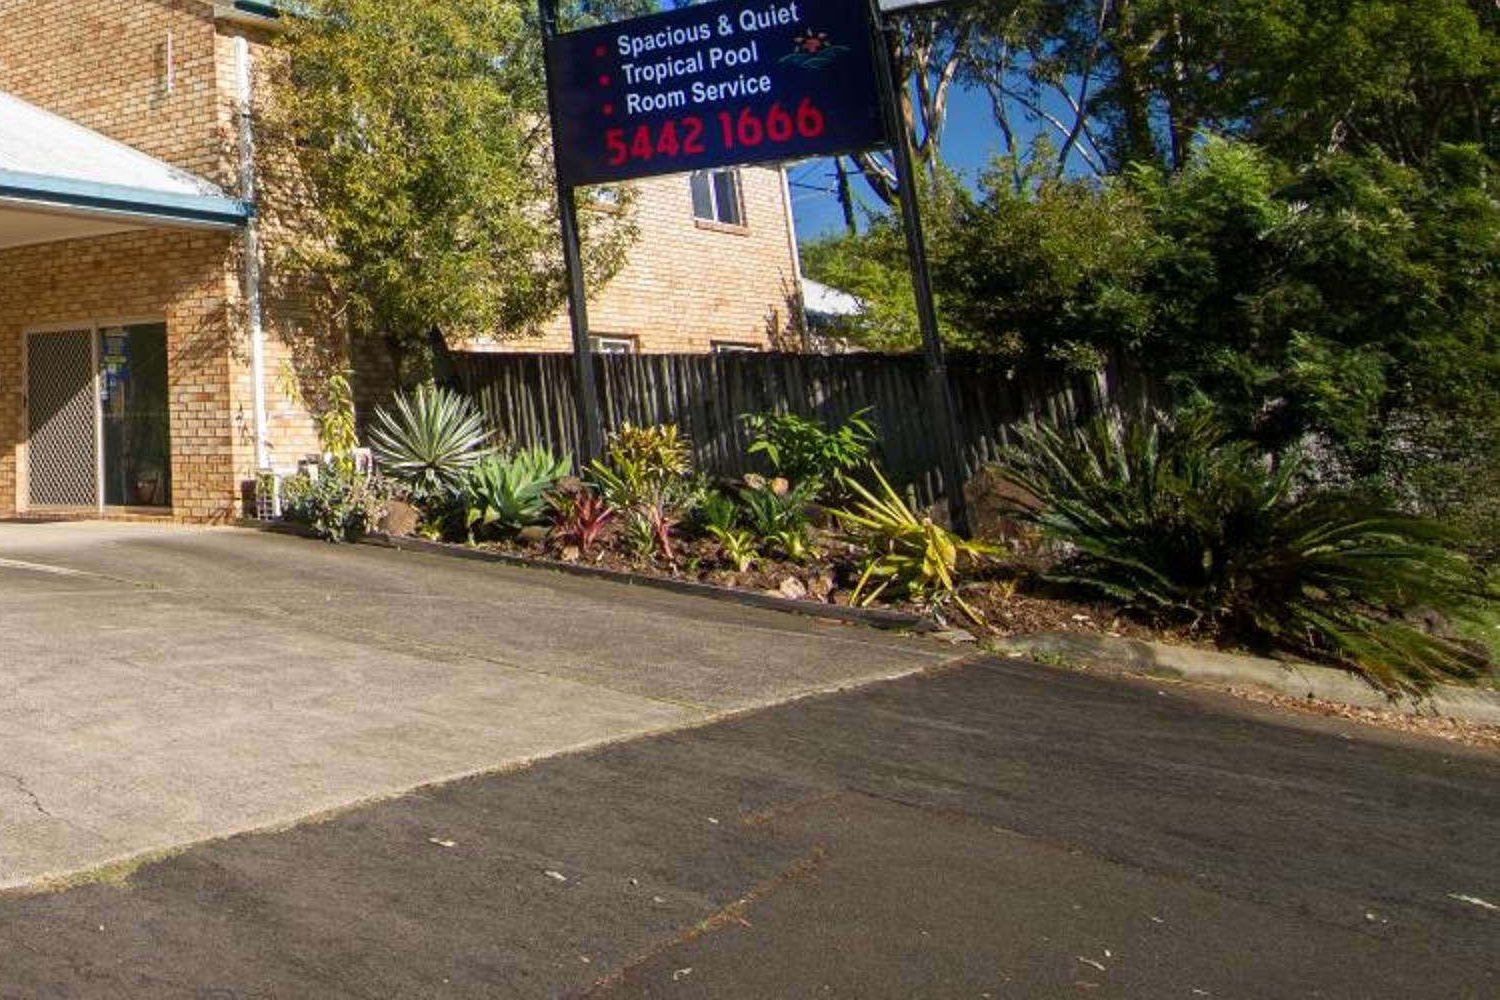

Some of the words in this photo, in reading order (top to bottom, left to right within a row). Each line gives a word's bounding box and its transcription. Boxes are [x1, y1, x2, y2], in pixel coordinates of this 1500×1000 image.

[617, 22, 711, 57] Spacious
[718, 14, 733, 36] &
[739, 1, 801, 32] Quiet
[622, 51, 704, 85] Tropical
[709, 41, 758, 69] Pool
[626, 89, 686, 115] Room
[691, 74, 772, 103] Service
[606, 116, 705, 165] 5442
[717, 97, 825, 149] 1666
